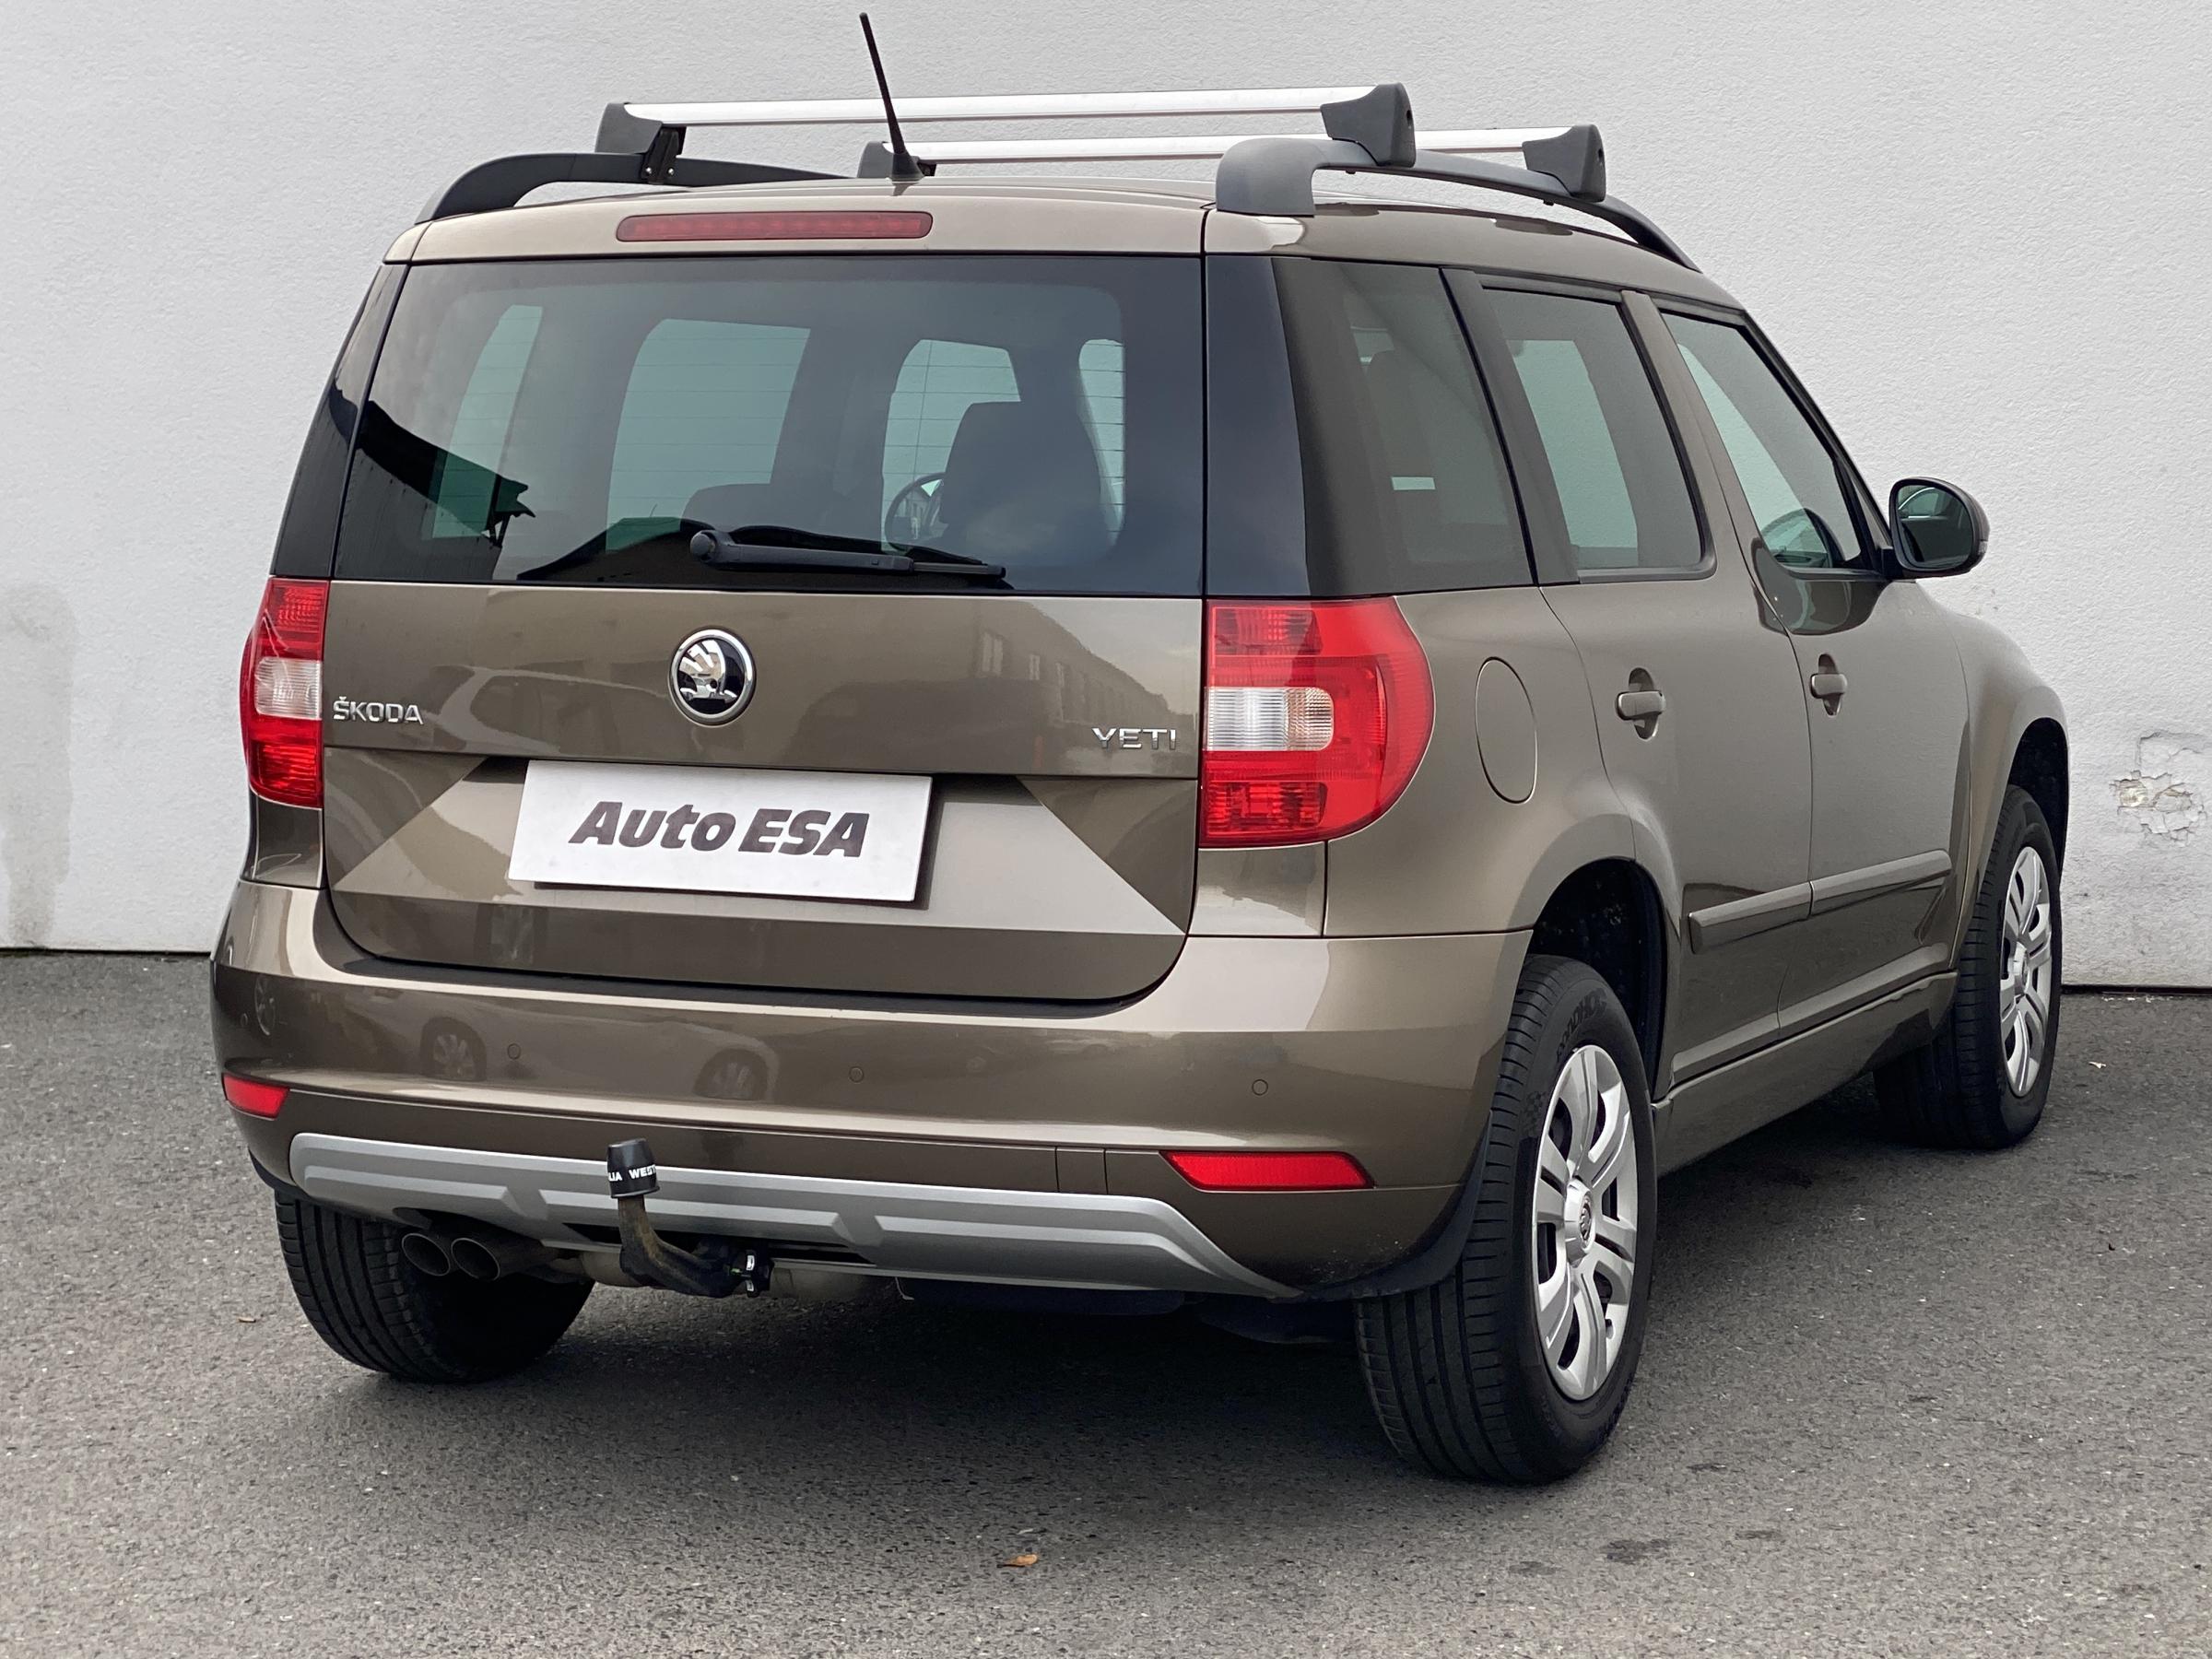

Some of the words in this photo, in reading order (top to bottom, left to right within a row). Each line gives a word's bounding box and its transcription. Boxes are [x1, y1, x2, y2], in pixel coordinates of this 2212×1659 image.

[333, 696, 424, 725] ŠKODA
[1091, 727, 1176, 750] YETI
[568, 801, 736, 853] Auto
[738, 809, 870, 858] ESA
